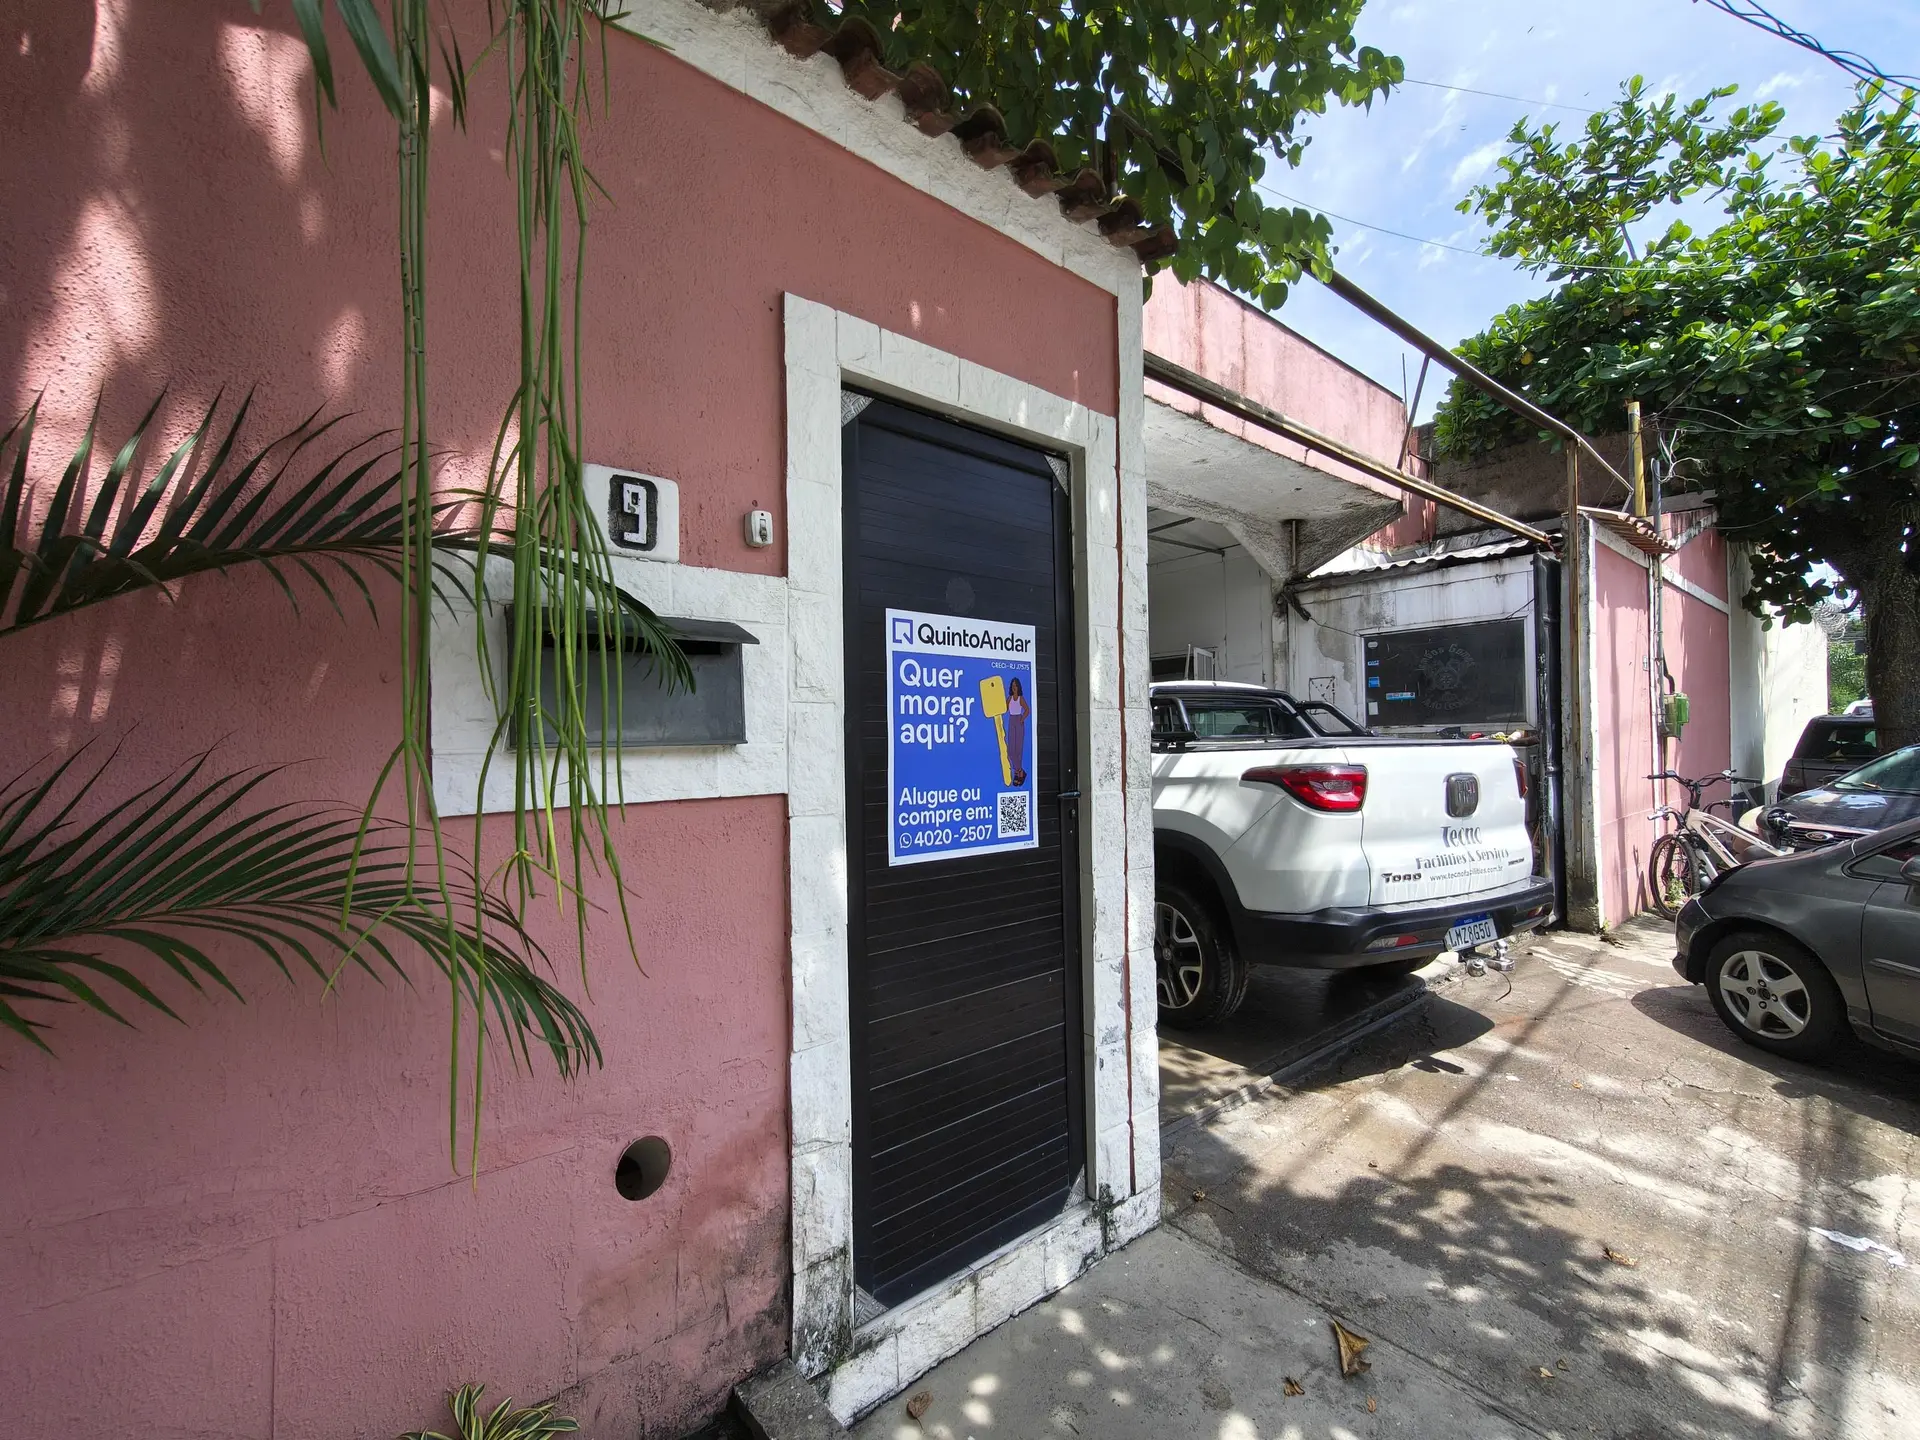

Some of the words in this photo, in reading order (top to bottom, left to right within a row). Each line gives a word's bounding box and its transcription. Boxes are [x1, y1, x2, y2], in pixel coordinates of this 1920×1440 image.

[621, 480, 650, 547] 9
[917, 623, 1031, 653] QuintoAndar
[899, 658, 964, 689] Quer
[900, 693, 975, 717] morar
[900, 717, 969, 750] aqui?
[899, 787, 958, 808] Alugue
[961, 788, 981, 801] ou
[898, 809, 961, 829] compre
[966, 805, 993, 820] em:
[914, 825, 993, 848] 4020-2507
[1415, 853, 1467, 870] Facilities
[1448, 921, 1491, 947] LMZ8G50
